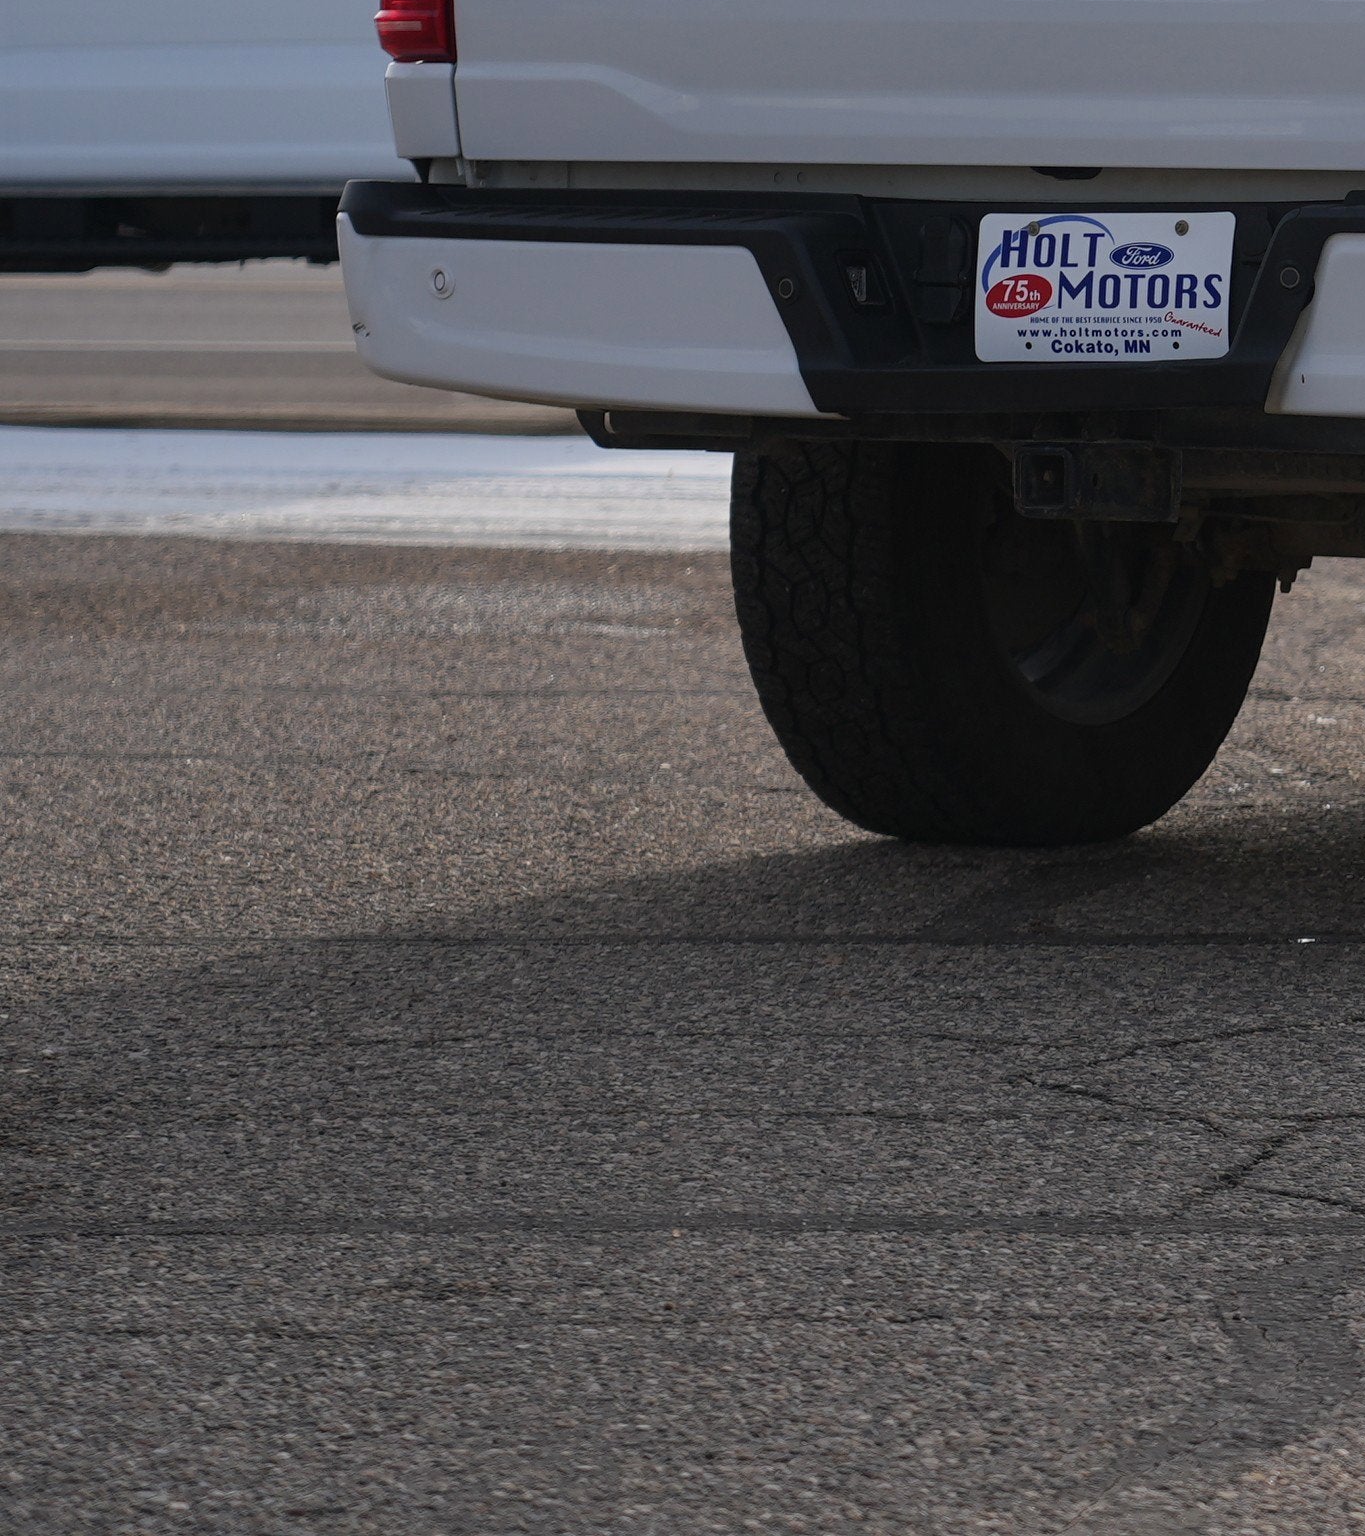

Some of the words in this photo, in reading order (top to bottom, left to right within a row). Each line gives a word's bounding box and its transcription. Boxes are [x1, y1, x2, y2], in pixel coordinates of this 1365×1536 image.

[1000, 229, 1105, 268] HOLT
[1121, 246, 1162, 266] Ford
[1002, 279, 1041, 302] 75th
[1058, 270, 1223, 310] MOTORS
[992, 302, 1040, 310] ANNIVERSARY
[1017, 327, 1182, 338] www.holtmotors.com
[1030, 316, 1050, 324] HOME
[1051, 316, 1060, 324] OF
[1061, 316, 1074, 324] THE
[1075, 316, 1092, 324] BEST
[1093, 316, 1121, 324] SERVICE
[1122, 316, 1142, 324] SINCE
[1145, 316, 1162, 324] 1950
[1164, 311, 1223, 338] Guaranteed
[1051, 339, 1119, 357] Cokato,
[1124, 339, 1151, 354] MN
